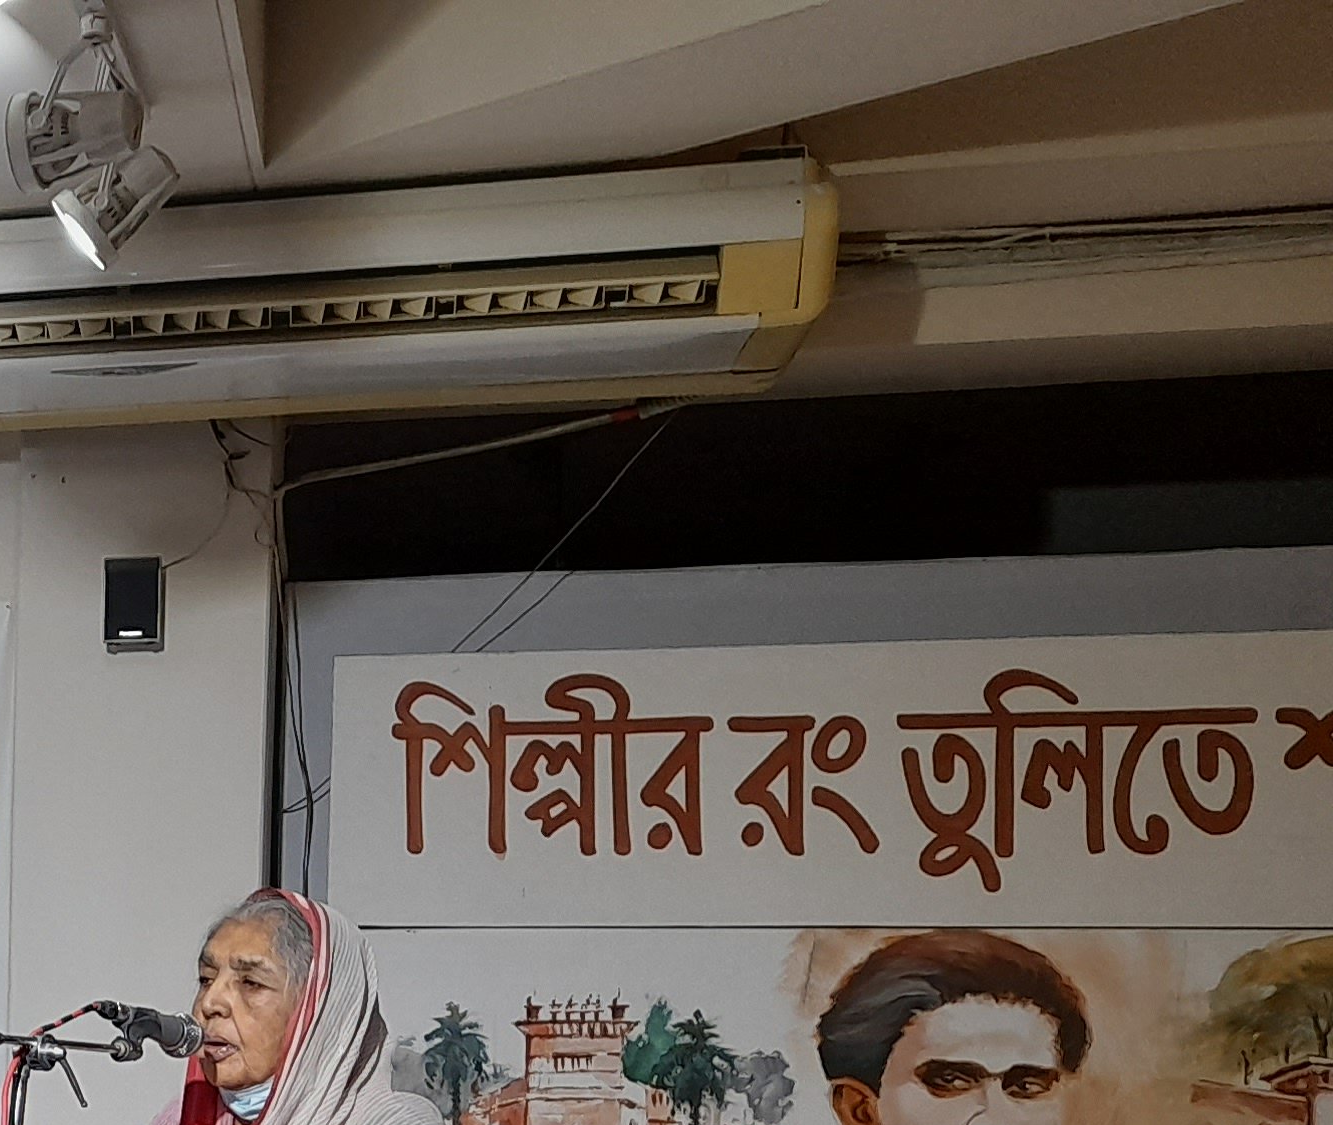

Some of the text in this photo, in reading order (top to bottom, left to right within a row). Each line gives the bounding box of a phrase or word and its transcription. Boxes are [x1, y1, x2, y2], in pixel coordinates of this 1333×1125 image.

[392, 667, 1258, 893] শিল্পীর রং তুলিতে
